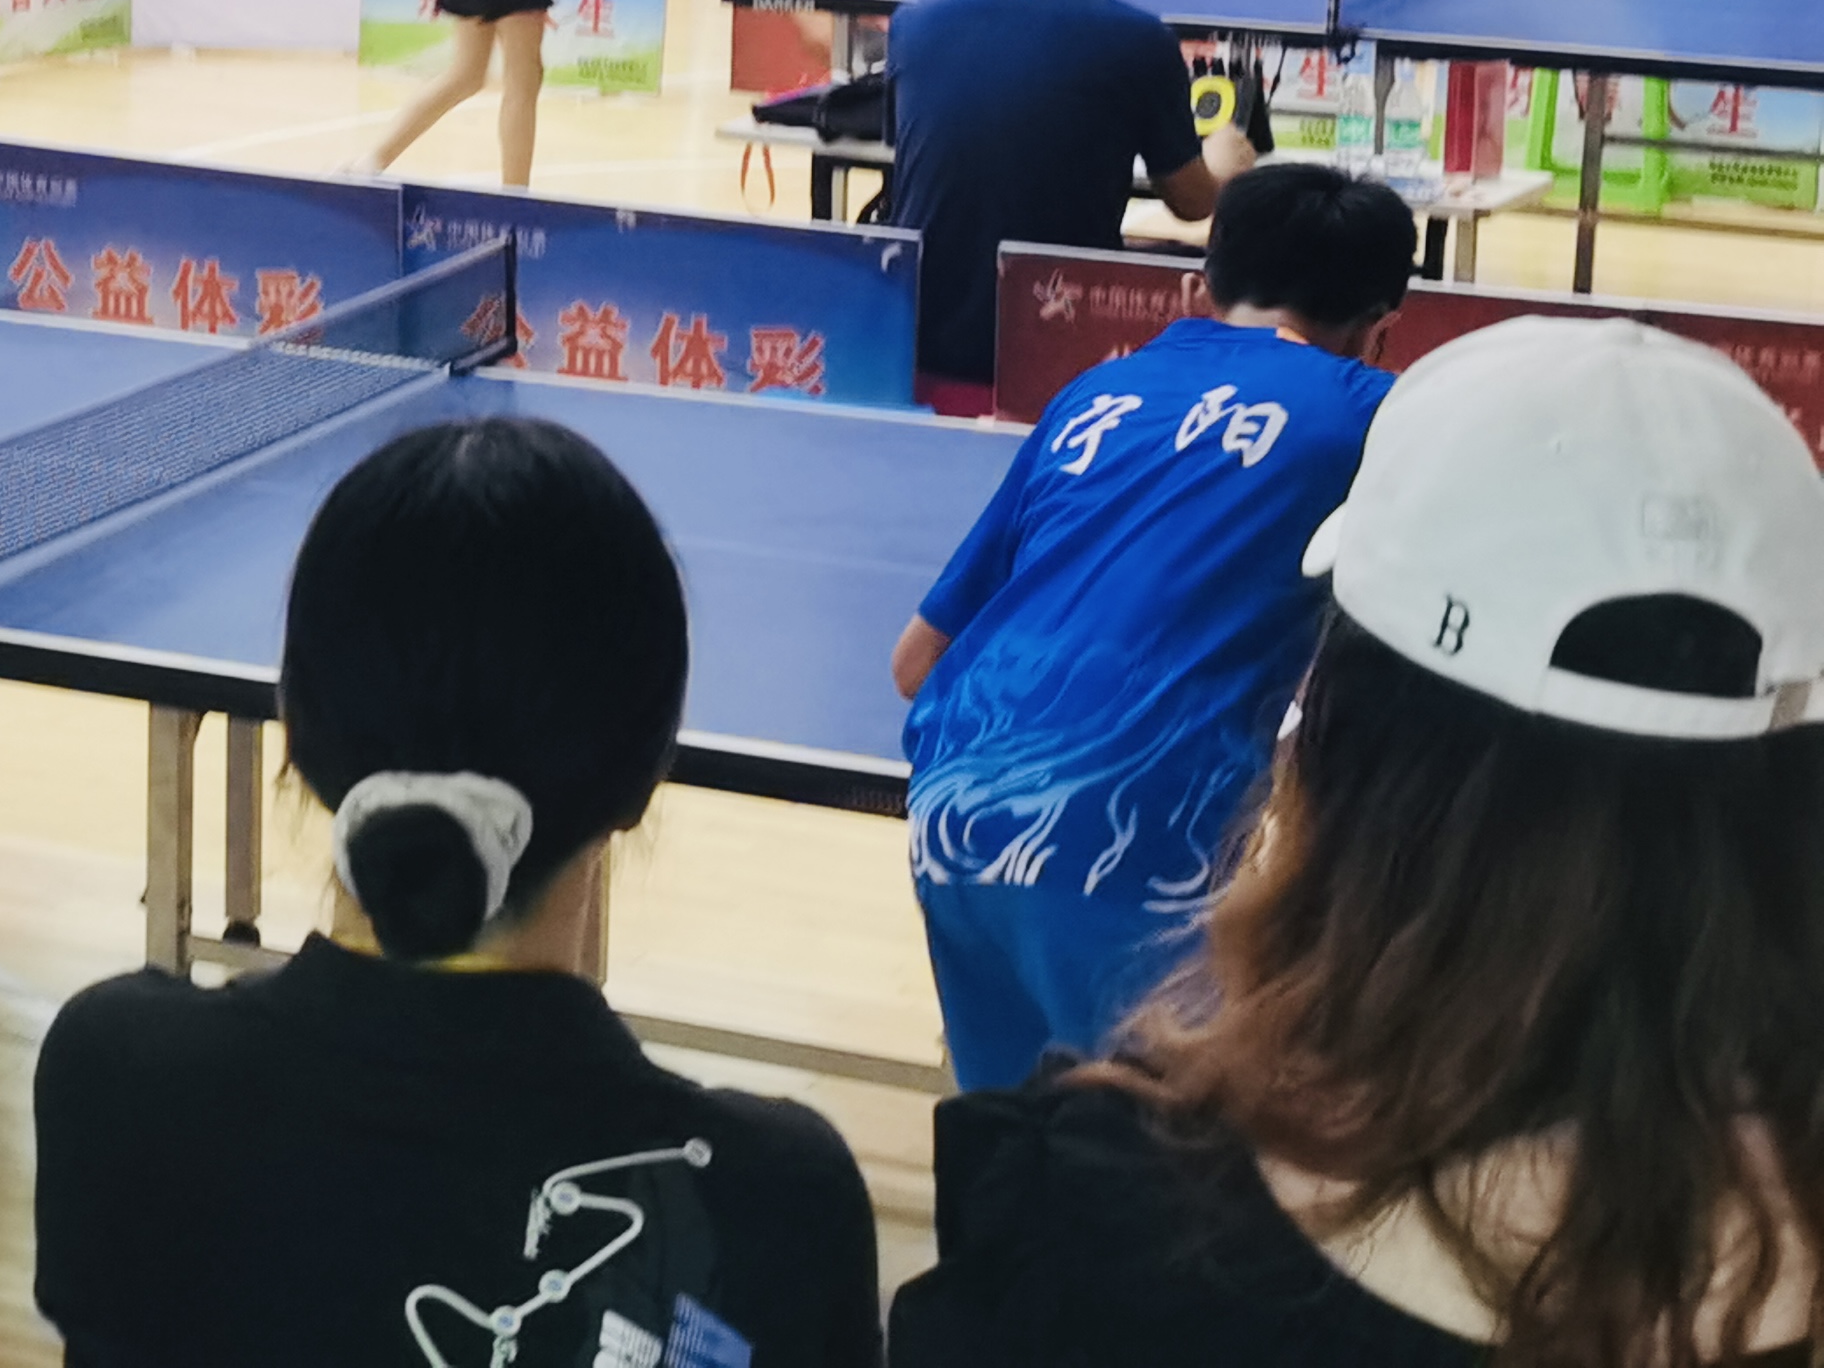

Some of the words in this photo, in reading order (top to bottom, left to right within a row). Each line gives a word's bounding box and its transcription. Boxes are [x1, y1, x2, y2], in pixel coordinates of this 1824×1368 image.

[8, 236, 324, 336] 公益体彩
[1431, 593, 1473, 658] B
